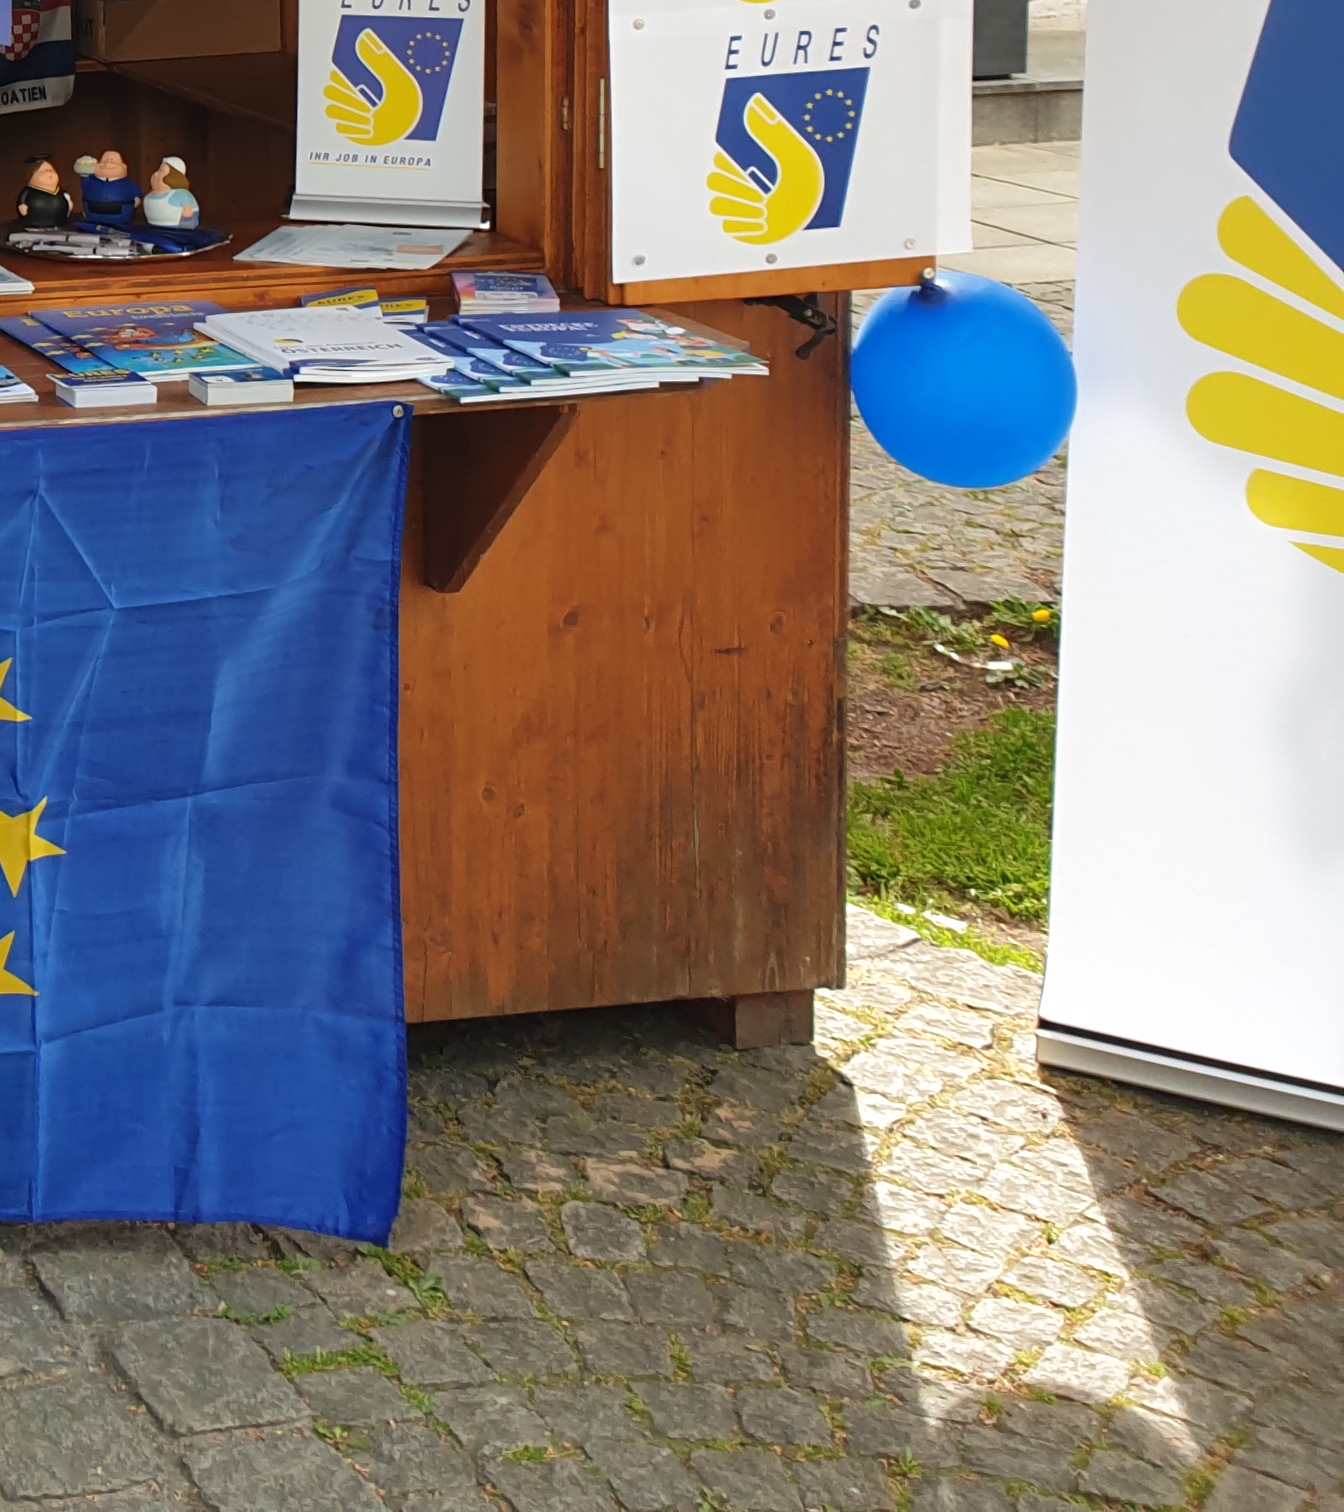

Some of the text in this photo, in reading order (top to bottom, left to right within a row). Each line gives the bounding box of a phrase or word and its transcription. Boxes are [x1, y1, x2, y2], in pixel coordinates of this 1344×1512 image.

[724, 23, 881, 71] EURES
[309, 151, 432, 167] IHR JOB IN EUROPA
[63, 303, 195, 319] Europa
[281, 342, 403, 354] ÖSTERREICH
